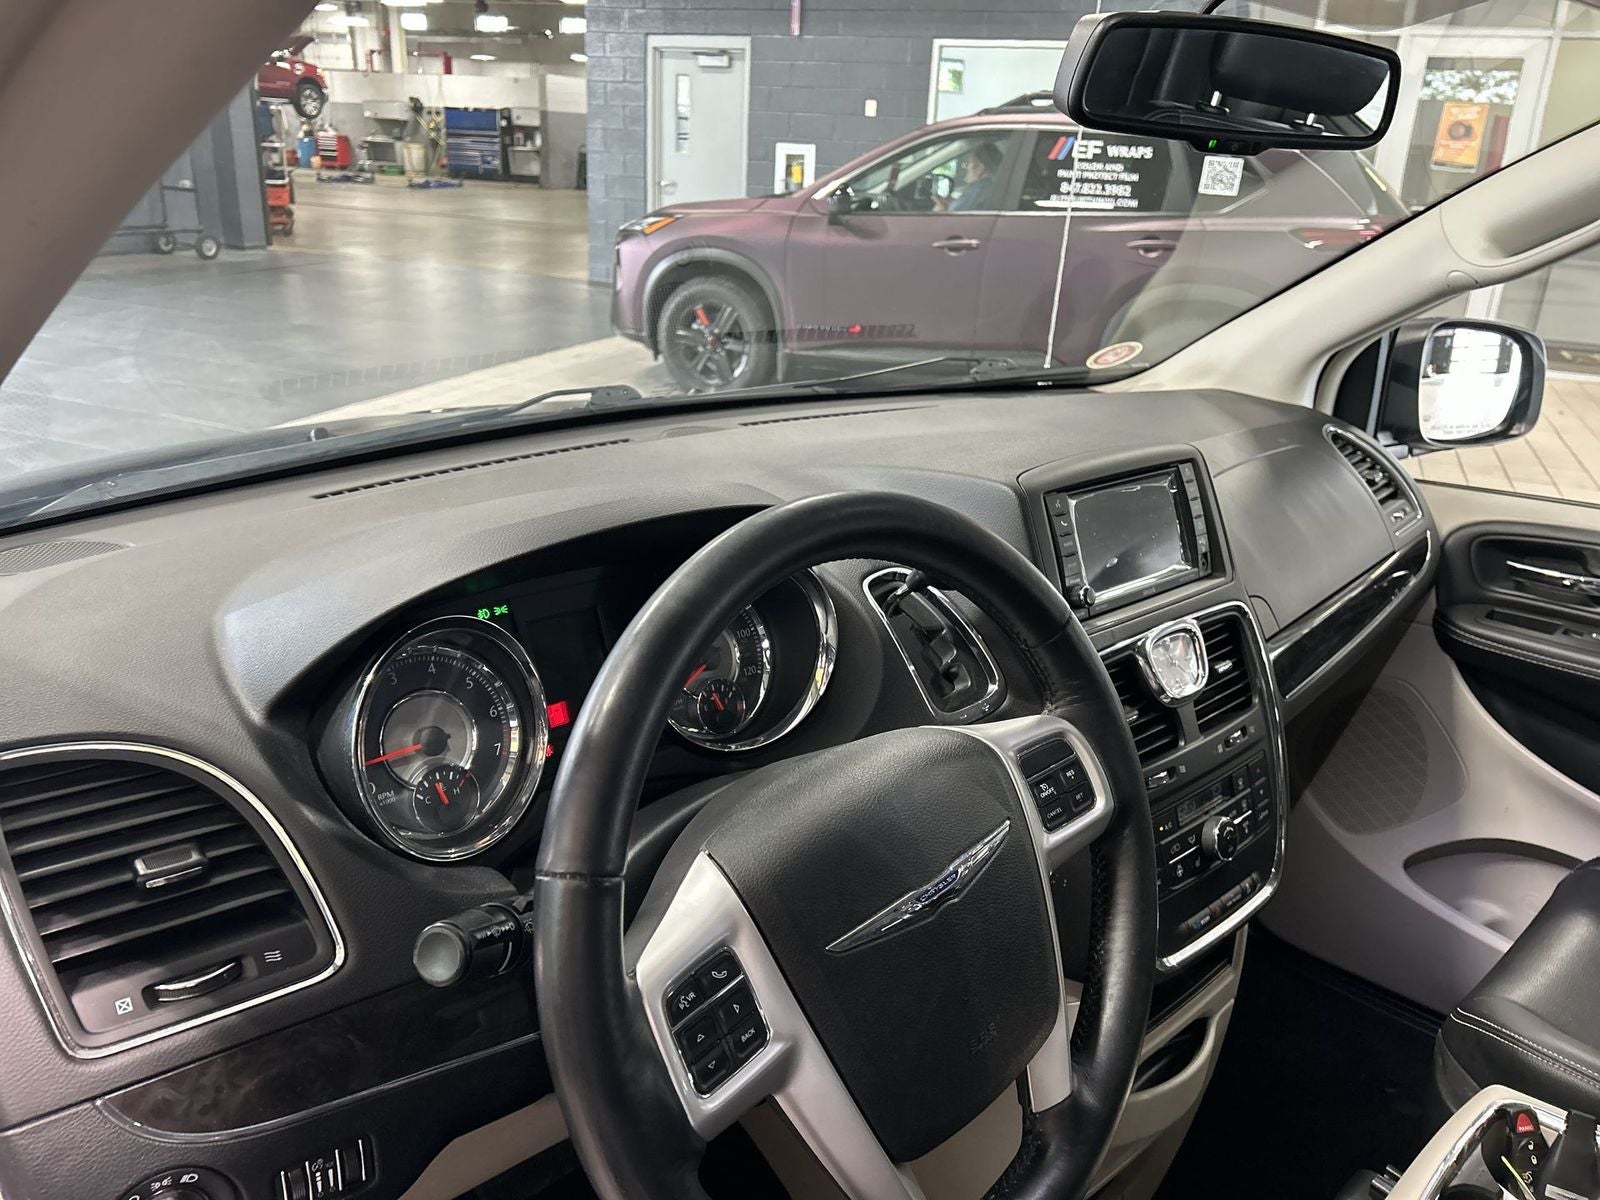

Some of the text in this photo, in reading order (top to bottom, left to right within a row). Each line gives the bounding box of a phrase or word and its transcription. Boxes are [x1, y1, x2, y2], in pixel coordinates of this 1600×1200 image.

[1106, 144, 1154, 159] WRAPS
[736, 628, 750, 640] 100
[427, 662, 436, 675] 4
[743, 664, 757, 676] 120
[389, 671, 398, 686] 3
[465, 676, 474, 690] 5
[489, 704, 498, 718] 6
[493, 742, 501, 757] 7
[377, 789, 395, 801] RPM
[453, 786, 460, 795] H
[425, 796, 432, 805] C
[1046, 807, 1062, 819] CANCEL
[685, 991, 697, 1002] VR
[740, 1027, 756, 1044] BACK
